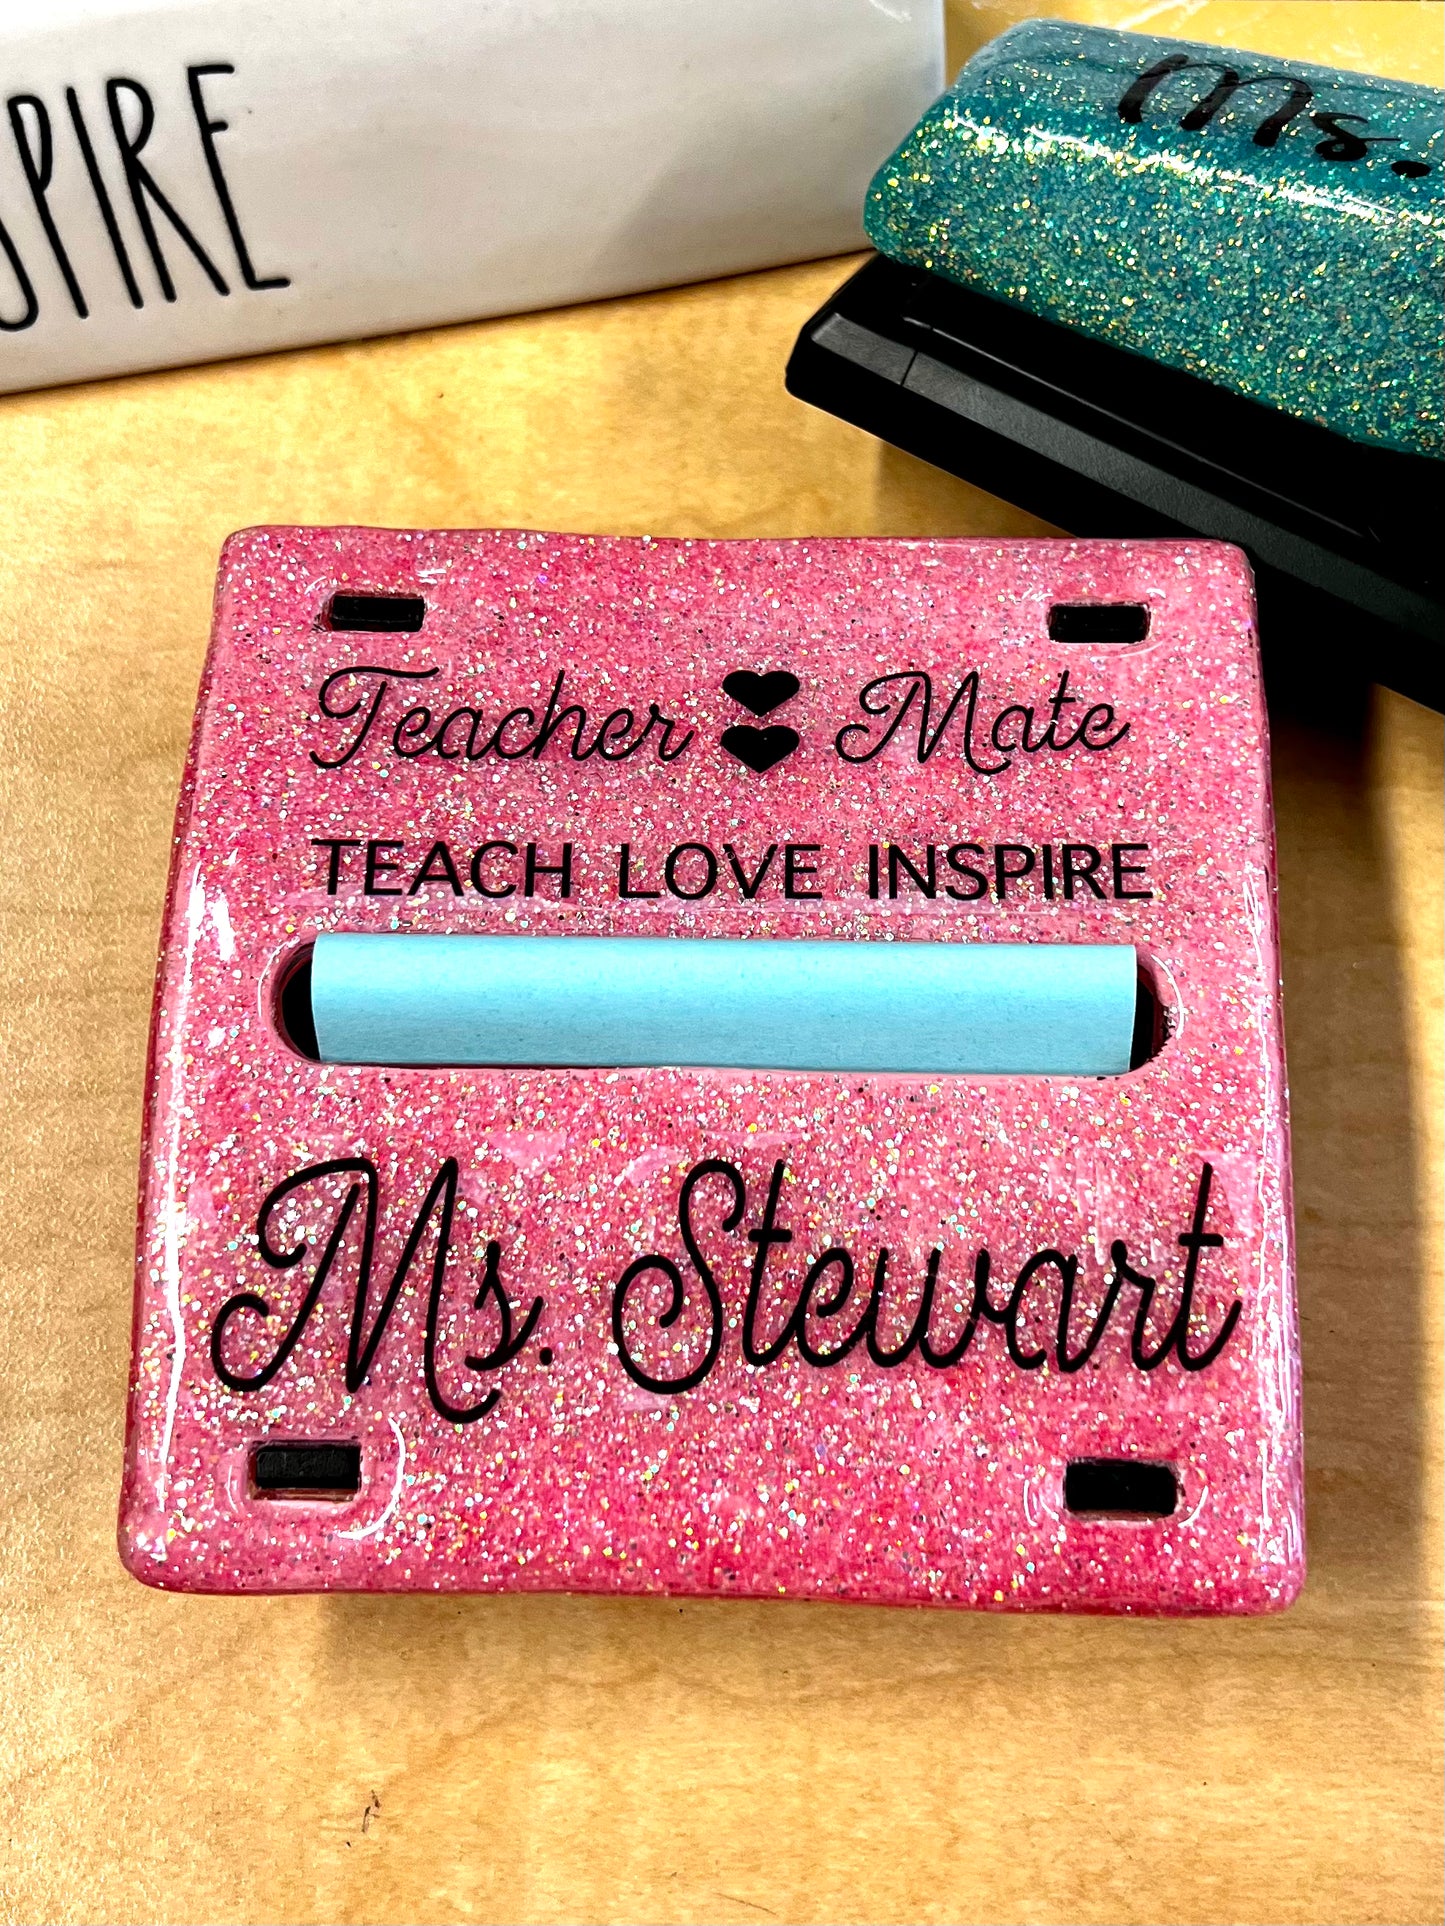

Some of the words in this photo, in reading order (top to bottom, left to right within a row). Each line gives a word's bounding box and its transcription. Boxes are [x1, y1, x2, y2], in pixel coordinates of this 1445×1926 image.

[1116, 54, 1432, 178] Ms.
[310, 666, 695, 769] Teacher
[835, 669, 1130, 775] Mate
[311, 838, 573, 898] TEACH
[618, 843, 821, 900] LOVE
[867, 843, 1154, 901] INSPIRE
[210, 1156, 552, 1424] Ms.
[612, 1158, 1242, 1395] Stewart
